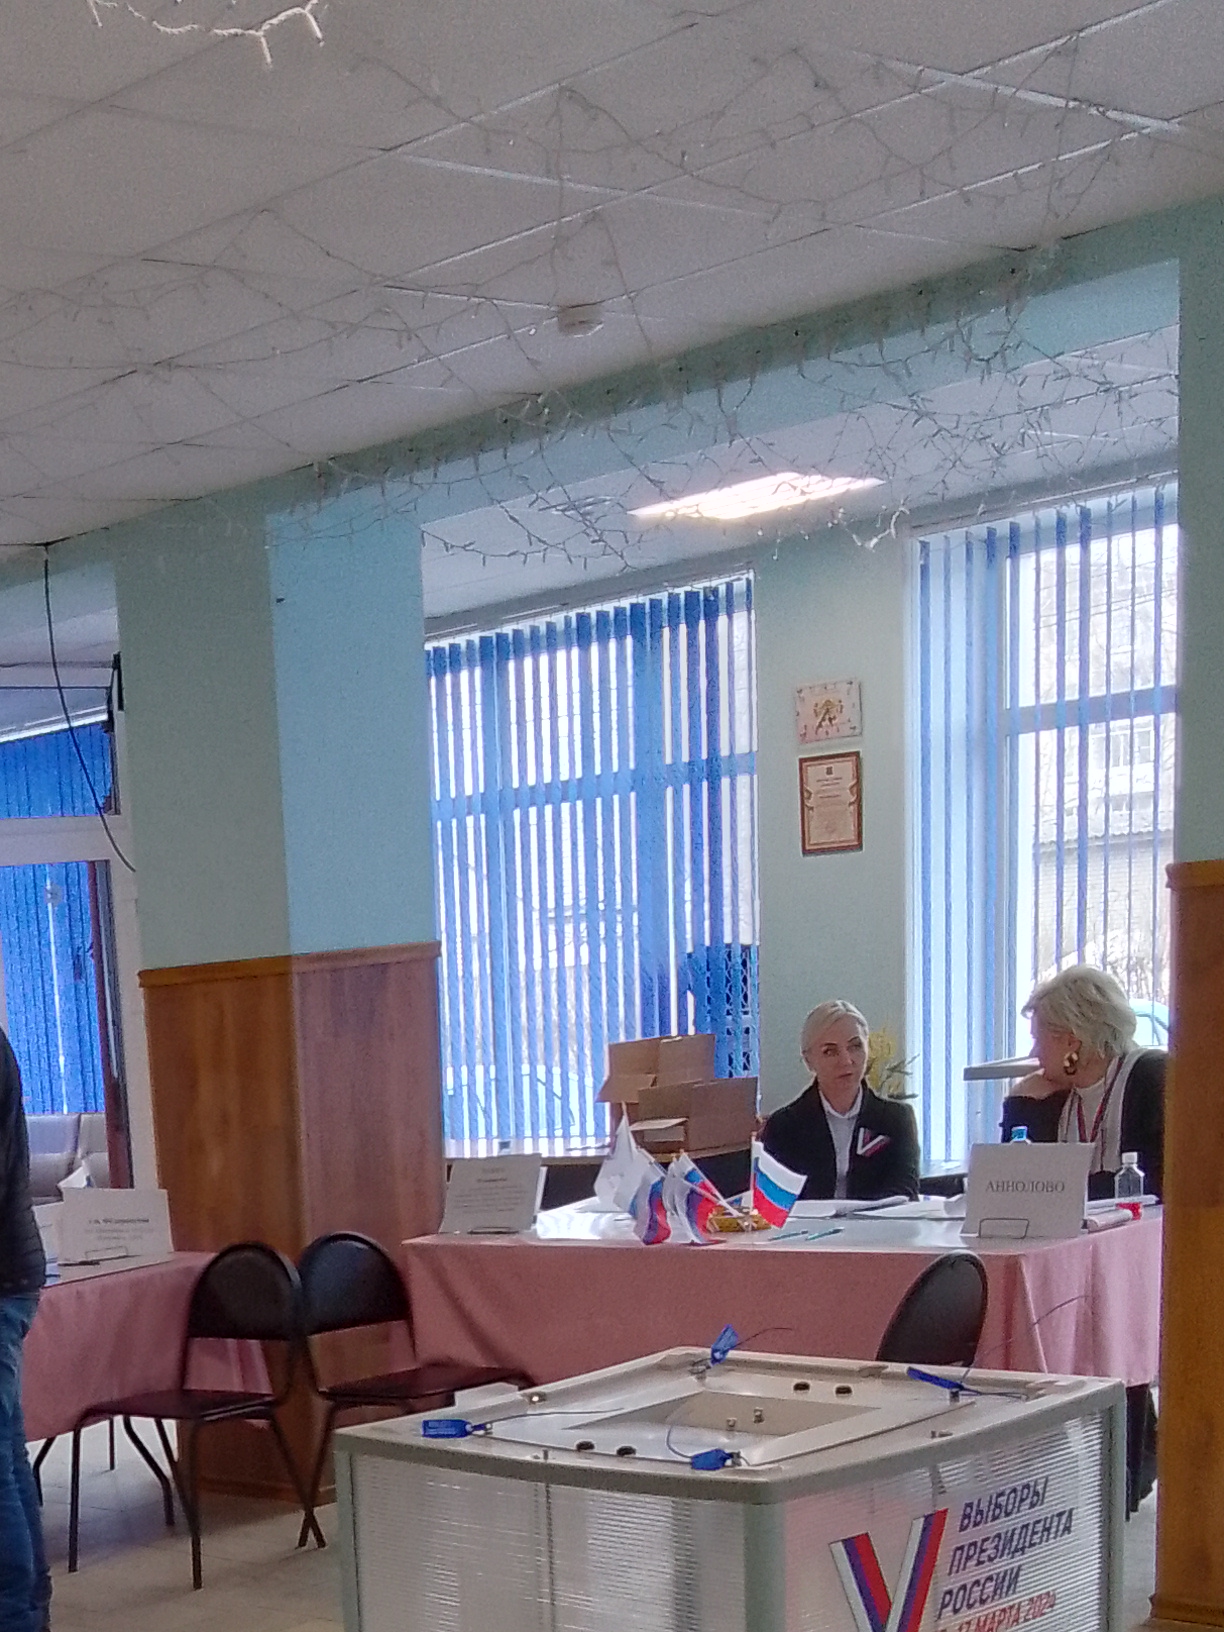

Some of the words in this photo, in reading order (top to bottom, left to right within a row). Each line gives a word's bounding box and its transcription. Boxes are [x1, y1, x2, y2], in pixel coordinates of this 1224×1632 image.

[985, 1180, 1066, 1194] АННОЛОВО
[959, 1476, 1049, 1532] ВЫБОРЫ
[947, 1508, 1074, 1576] ПРЕЗИДЕНТА
[935, 1565, 1021, 1621] РОССИИ
